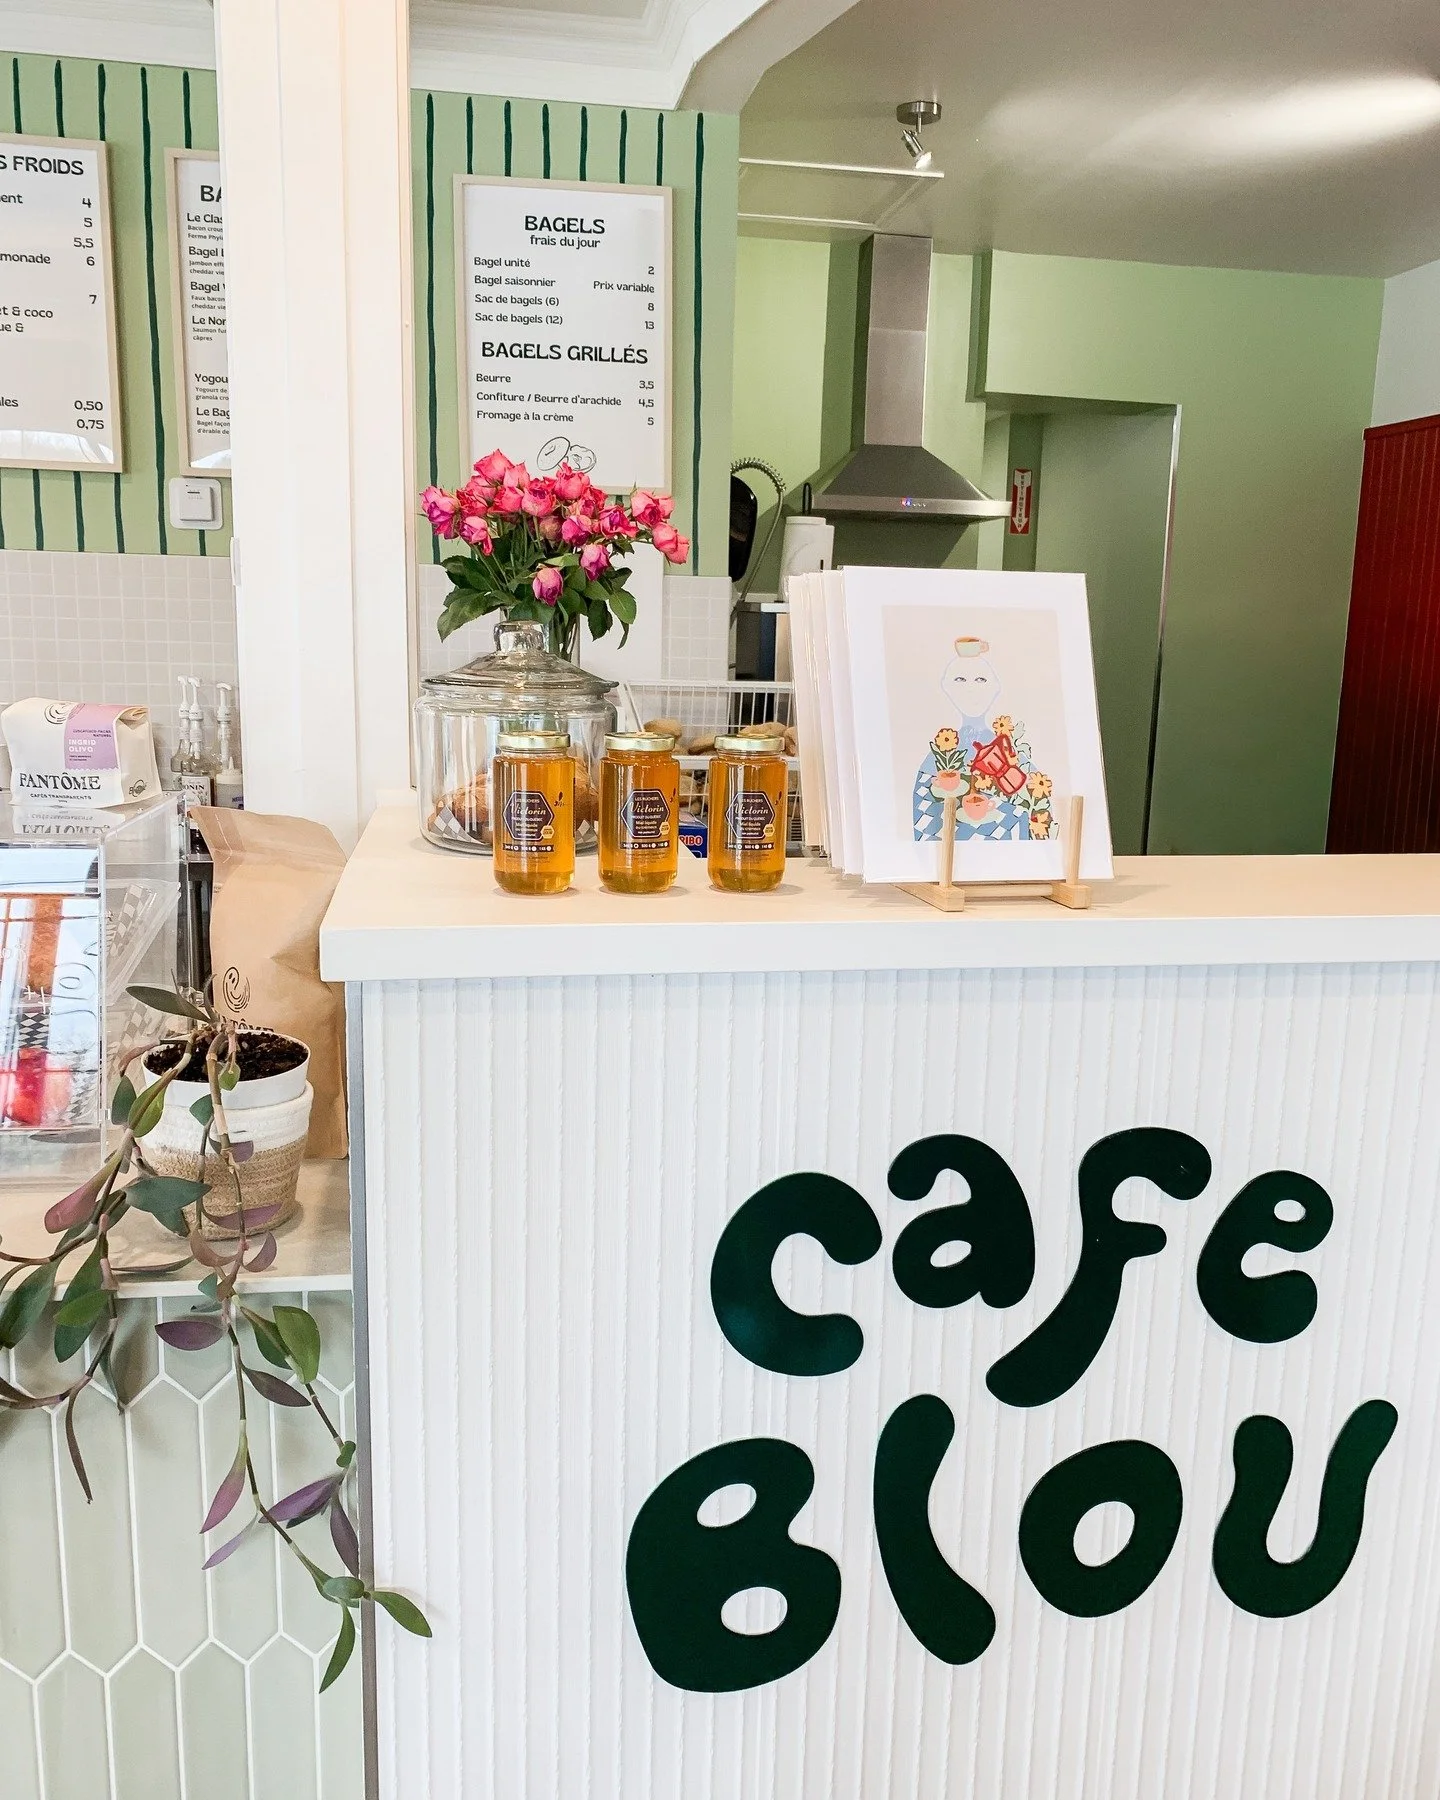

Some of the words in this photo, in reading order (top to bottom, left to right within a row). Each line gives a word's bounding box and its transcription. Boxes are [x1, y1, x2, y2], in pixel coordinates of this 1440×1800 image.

[13, 156, 83, 175] FROIDS
[82, 198, 91, 208] 4
[84, 218, 92, 227] 5
[187, 213, 200, 222] Le
[525, 215, 605, 234] BAGELS
[74, 238, 93, 248] 5,5
[530, 235, 556, 245] frais
[560, 237, 574, 246] du
[576, 237, 600, 249] jour
[189, 246, 218, 258] Bagel
[87, 256, 95, 266] 6
[474, 257, 501, 268] Bagel
[505, 259, 530, 267] unité
[648, 266, 654, 275] 2
[475, 275, 501, 286] Bagel
[505, 277, 555, 286] saisonnier
[191, 282, 219, 293] Bagel
[594, 281, 613, 290] Prix
[617, 283, 654, 293] variable
[89, 295, 96, 304] 7
[475, 294, 492, 303] Sac
[496, 295, 507, 303] de
[511, 295, 542, 306] bagels
[546, 297, 559, 306] (6)
[648, 303, 654, 311] 8
[12, 307, 20, 316] &
[25, 309, 53, 318] coco
[192, 316, 205, 324] Le
[475, 313, 493, 321] Sac
[496, 314, 508, 322] de
[511, 314, 542, 325] bagels
[546, 316, 562, 325] (12)
[16, 323, 24, 332] &
[645, 321, 654, 329] 13
[482, 342, 561, 359] BAGELS
[568, 345, 648, 364] GRILLÉS
[477, 374, 511, 382] Beurre
[639, 381, 654, 389] 3,5
[477, 392, 524, 401] Confiture
[535, 394, 568, 403] Beurre
[571, 395, 621, 405] d'arachide
[639, 399, 654, 408] 4,5
[74, 401, 103, 411] 0,50
[197, 407, 209, 416] Le
[477, 411, 521, 422] Fromage
[524, 412, 529, 420] à
[532, 412, 540, 420] la
[543, 413, 573, 421] crème
[77, 419, 104, 429] 0,75
[648, 417, 654, 425] 5
[20, 772, 100, 790] FANTÔME
[510, 803, 546, 815] Victorin
[629, 801, 664, 813] Victorin
[734, 803, 768, 815] Victorin
